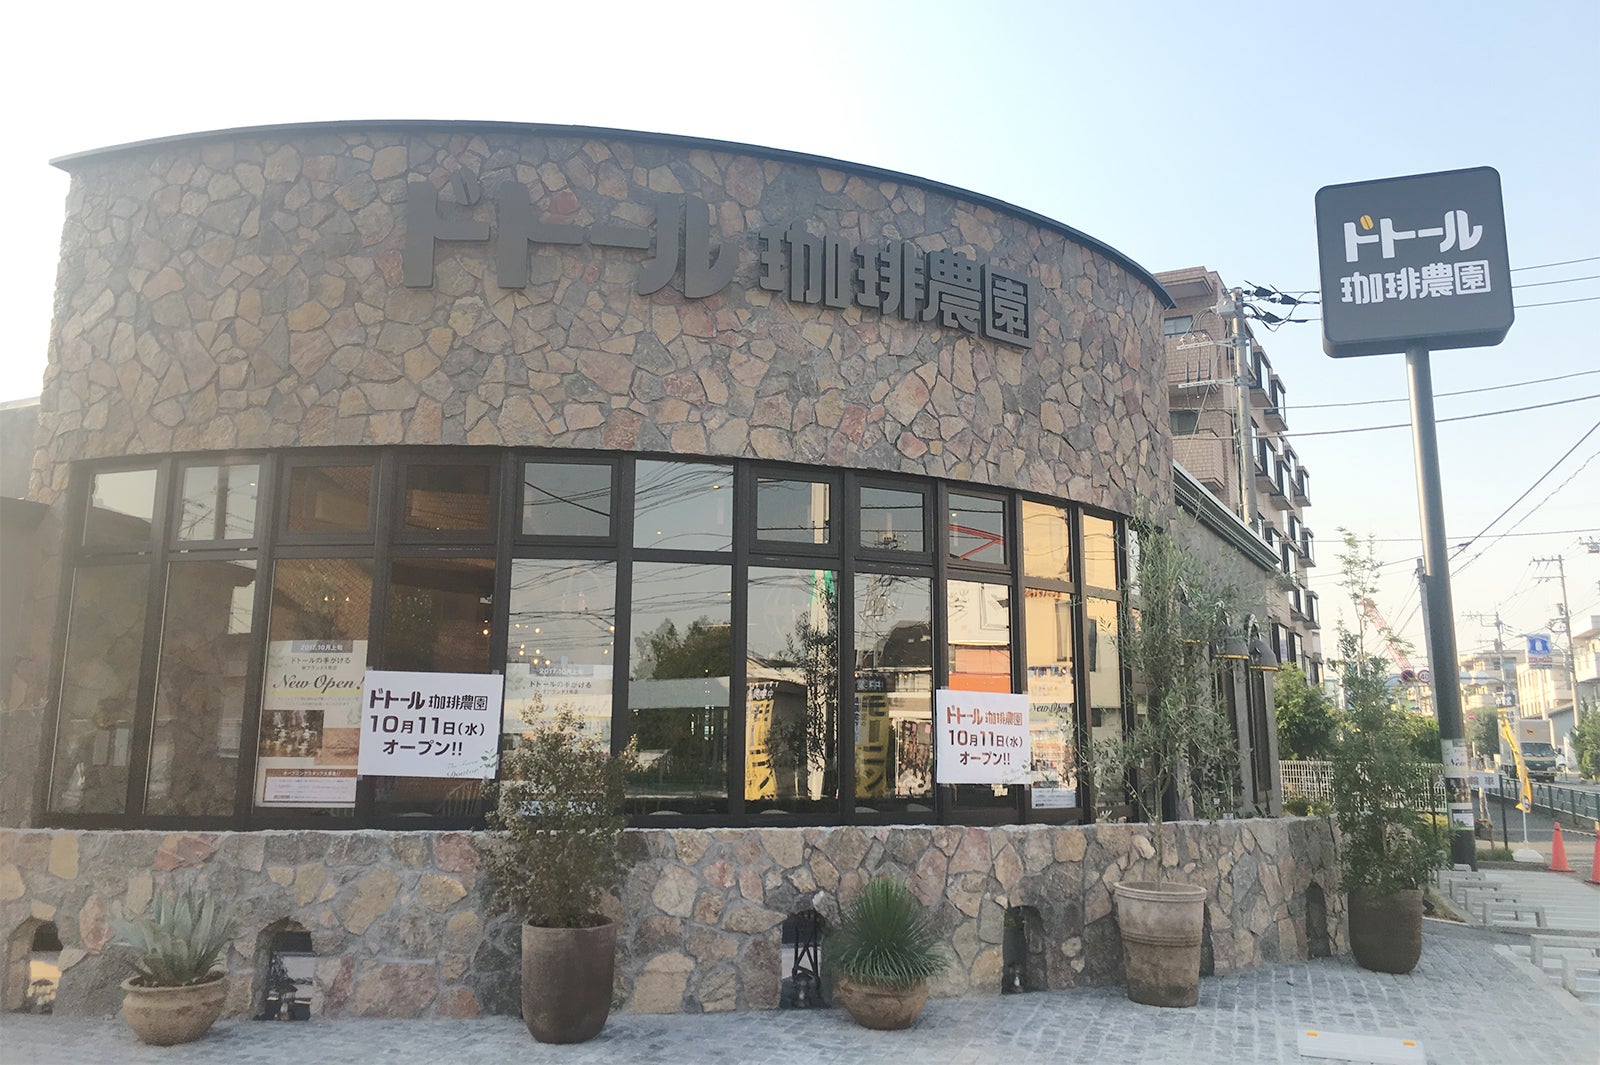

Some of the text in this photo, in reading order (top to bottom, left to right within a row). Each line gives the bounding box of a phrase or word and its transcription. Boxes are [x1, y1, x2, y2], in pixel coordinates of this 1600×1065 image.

[1344, 210, 1483, 262] ドトール
[404, 167, 1034, 349] ドトール 珈琲農園
[1340, 260, 1491, 304] 珈琲農園
[273, 674, 309, 688] New
[370, 688, 488, 711] ドトール 珈琲農園
[370, 715, 485, 736] 10月11日(水)
[947, 705, 1022, 726] ドトール 珈琲農園
[383, 739, 463, 756] オープン!!
[949, 729, 1023, 747] 10月11日(水)
[960, 751, 1010, 766] オープン!!
